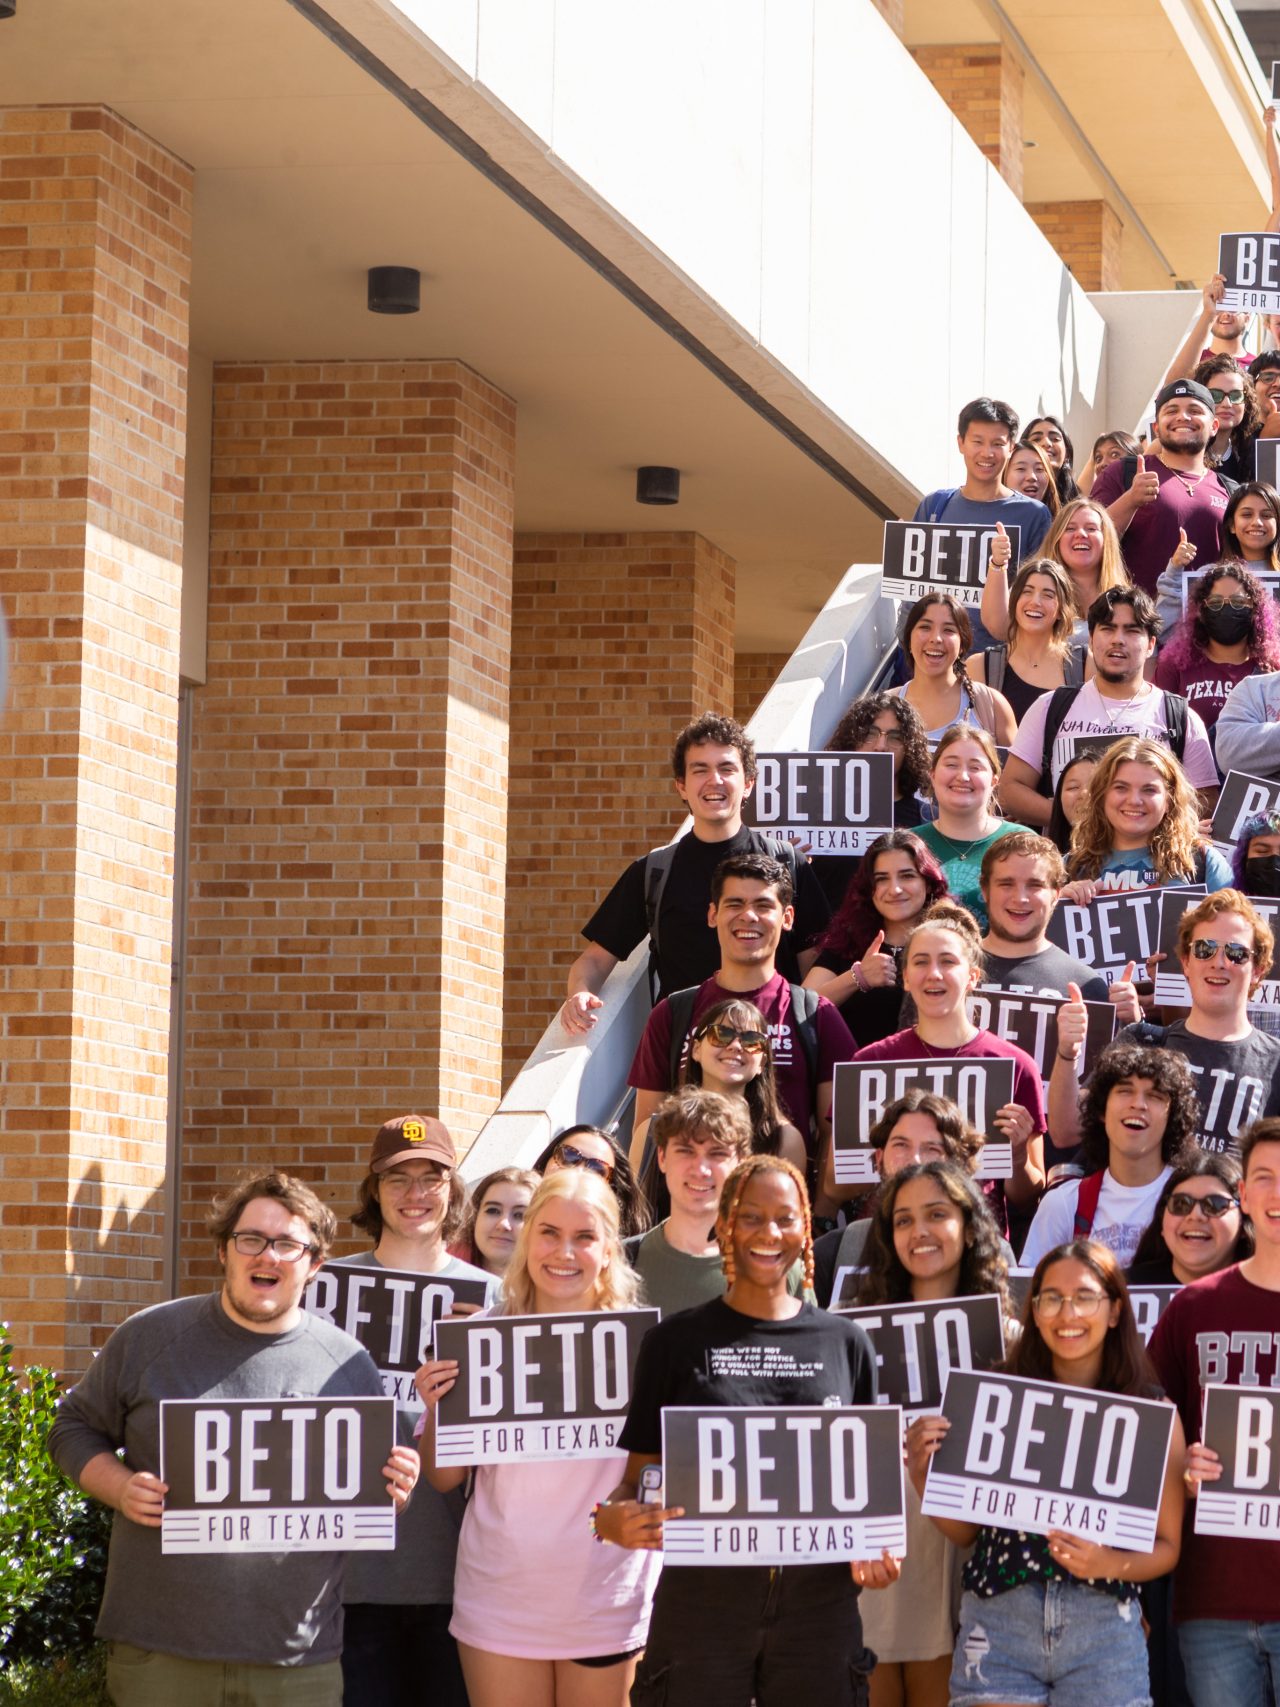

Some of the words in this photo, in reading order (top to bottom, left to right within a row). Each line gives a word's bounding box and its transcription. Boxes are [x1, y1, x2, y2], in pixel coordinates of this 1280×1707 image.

[1243, 293, 1267, 307] FOR
[1186, 680, 1233, 700] TEXAS
[756, 758, 870, 822] BETO
[807, 830, 859, 848] TEXAS
[467, 1320, 630, 1418] BETO
[194, 1407, 361, 1503] BETO
[482, 1426, 524, 1452] FOR
[542, 1423, 615, 1450] TEXAS
[964, 1381, 1140, 1498] BETO
[697, 1416, 869, 1513] BETO
[208, 1515, 250, 1542] FOR
[268, 1513, 344, 1540] TEXAS
[971, 1487, 1016, 1517] FOR
[1033, 1496, 1108, 1532] TEXAS
[714, 1526, 758, 1553] FOR
[776, 1525, 854, 1551] TEXAS
